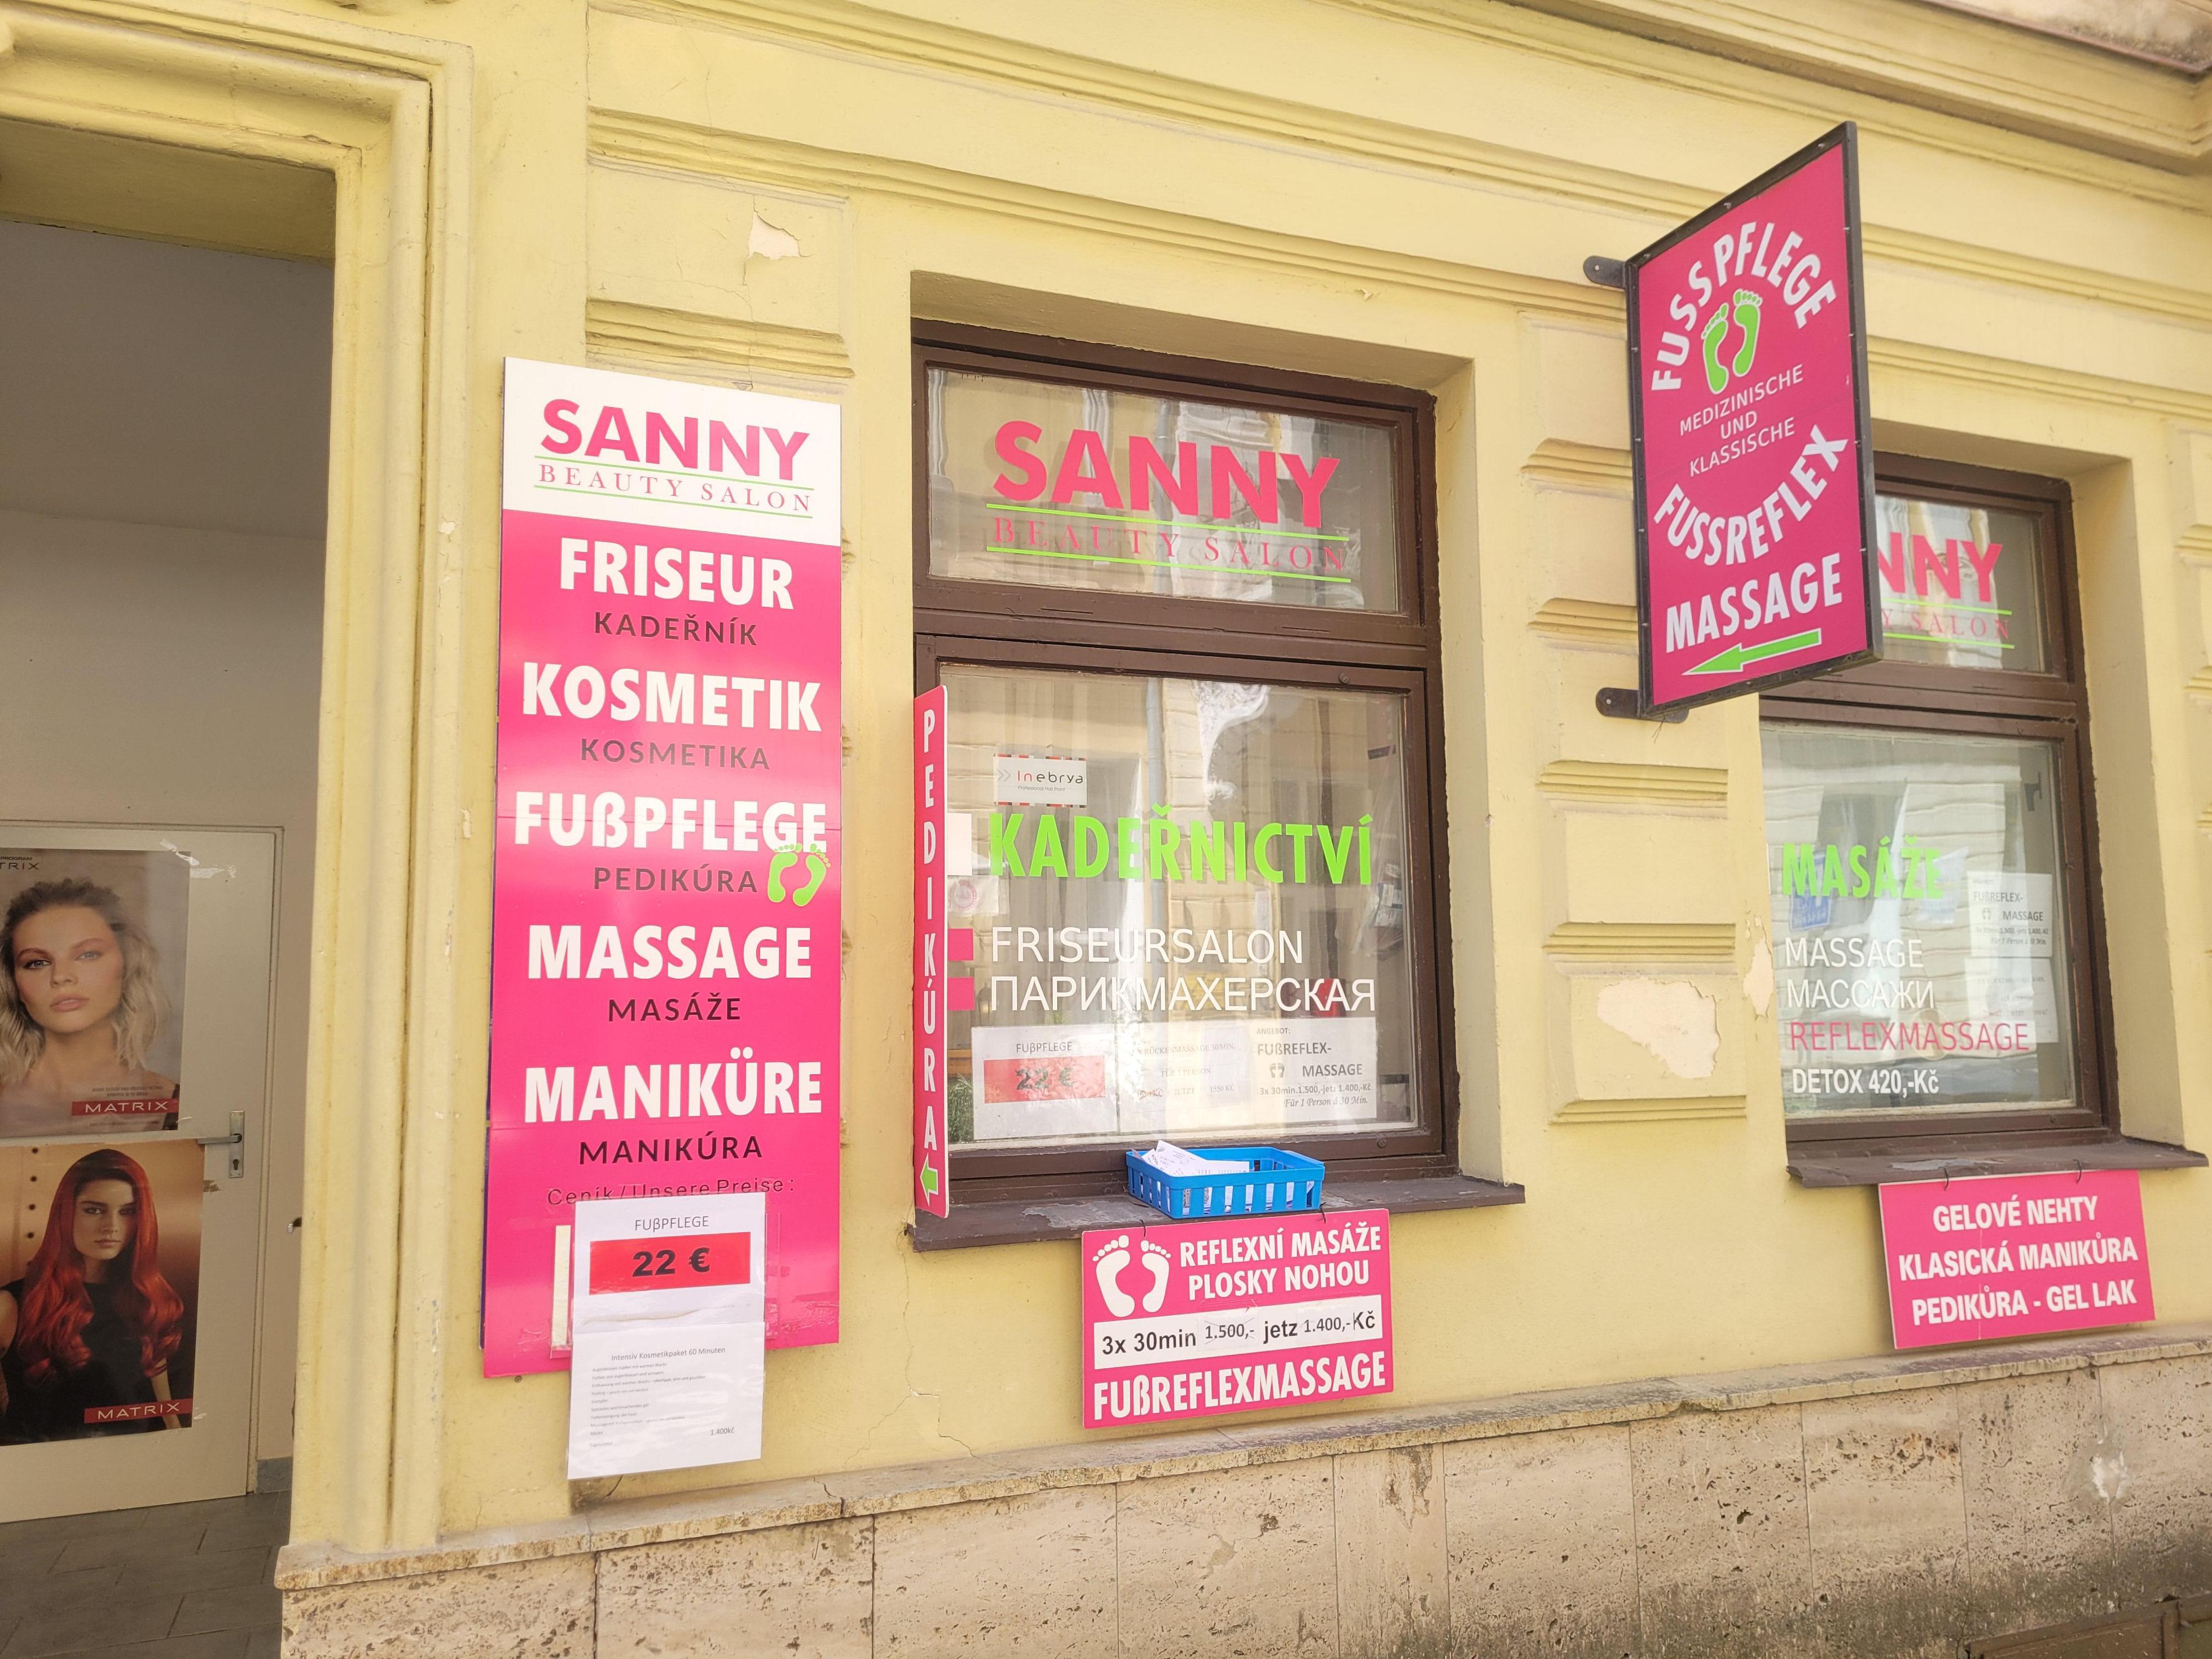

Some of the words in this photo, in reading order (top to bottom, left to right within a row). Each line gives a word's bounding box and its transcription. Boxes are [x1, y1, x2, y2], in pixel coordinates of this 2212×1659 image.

[1651, 221, 1837, 391] FUSSPFLEGE
[1680, 364, 1804, 436] MEDIZINISCHE
[540, 398, 810, 481] SANNY
[1720, 410, 1757, 439] UND
[1689, 418, 1796, 477] KLASSISCHE
[539, 464, 684, 498] BEAUTY
[701, 483, 812, 513] SALON
[993, 420, 1340, 529] SANNY
[1653, 425, 1848, 566] FUSSREFLEX
[994, 517, 1182, 557] BEAUTY
[1206, 536, 1345, 572] SALON
[560, 537, 794, 610] FRISEUR
[1877, 532, 2003, 602] NNY
[1666, 553, 1843, 653] MASSAGE
[594, 612, 757, 646] KADEŘNÍK
[1911, 611, 2008, 640] SALON
[523, 662, 822, 732] KOSMETIK
[581, 738, 770, 770] KOSMETIKA
[514, 791, 827, 853] FUßPFLEGE
[989, 802, 1373, 885] KADEŘNICTVÍ
[593, 863, 758, 893] PEDIKÚRA
[1782, 836, 1944, 899] MASÁŽE
[2002, 911, 2044, 921] MASSAGE
[528, 925, 812, 979] MASSAGE
[992, 926, 1303, 964] FRISEURSALON
[1785, 937, 1924, 968] MASSAGE
[608, 992, 741, 1022] MASÁŽE
[991, 975, 1376, 1012] ПАРИКМАХЕРСКАЯ
[1786, 979, 1934, 1009] МАССАЖИ
[1790, 1021, 2030, 1051] REFLEXMASSAGE
[524, 1046, 822, 1123] MANIKÜRE
[1302, 1063, 1363, 1077] MASSAGE
[1793, 1069, 1864, 1094] DETOX
[85, 1101, 168, 1113] MATRIX
[580, 1131, 763, 1165] MANIKÚRA
[717, 1177, 784, 1194] Preise
[1933, 1194, 2022, 1232] GELOVÉ
[2027, 1195, 2098, 1225] NEHTY
[632, 1249, 676, 1277] 22
[688, 1247, 711, 1273] €
[1180, 1227, 1284, 1267] REFLEXNÍ
[1291, 1221, 1381, 1258] MASÁŽE
[1898, 1240, 2015, 1281] KLASICKÁ
[2018, 1232, 2139, 1271] MANIKŮRA
[1188, 1267, 1277, 1301] PLOSKY
[1285, 1259, 1369, 1291] NOHOU
[1912, 1285, 2029, 1326] PEDIKŮRA
[2046, 1284, 2090, 1313] GEL
[2093, 1279, 2137, 1308] LAK
[611, 1353, 637, 1361] Intensiv
[639, 1350, 687, 1360] Kosmetikpaket
[1102, 1335, 1126, 1356] 3x
[1134, 1331, 1197, 1352] 30min
[1263, 1319, 1298, 1344] jetz
[1094, 1350, 1386, 1421] FUßREFLEXMASSAGE
[98, 1402, 180, 1420] MATRIX
